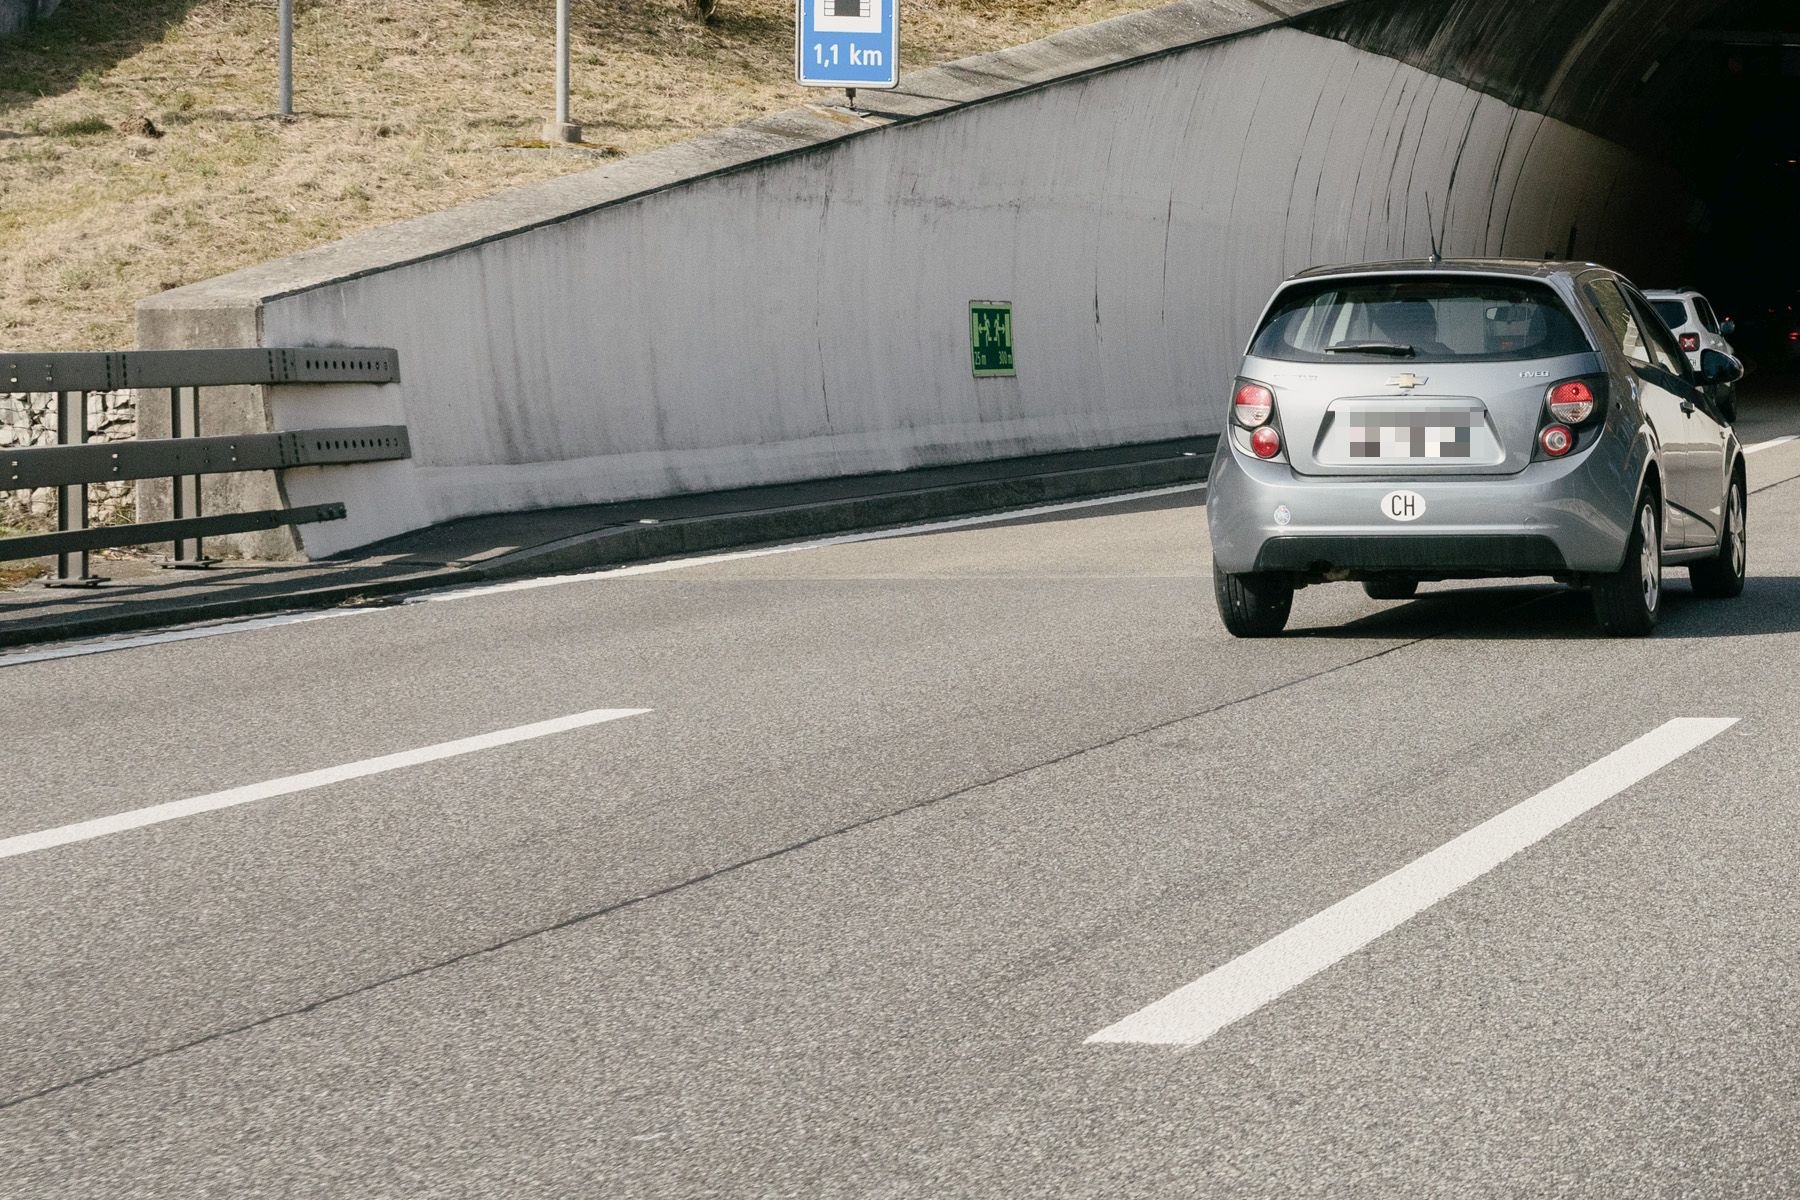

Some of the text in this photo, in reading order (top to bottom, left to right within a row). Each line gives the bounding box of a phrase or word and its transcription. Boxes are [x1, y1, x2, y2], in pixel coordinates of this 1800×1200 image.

[813, 43, 883, 68] 1,1 km
[1391, 494, 1415, 517] CH
